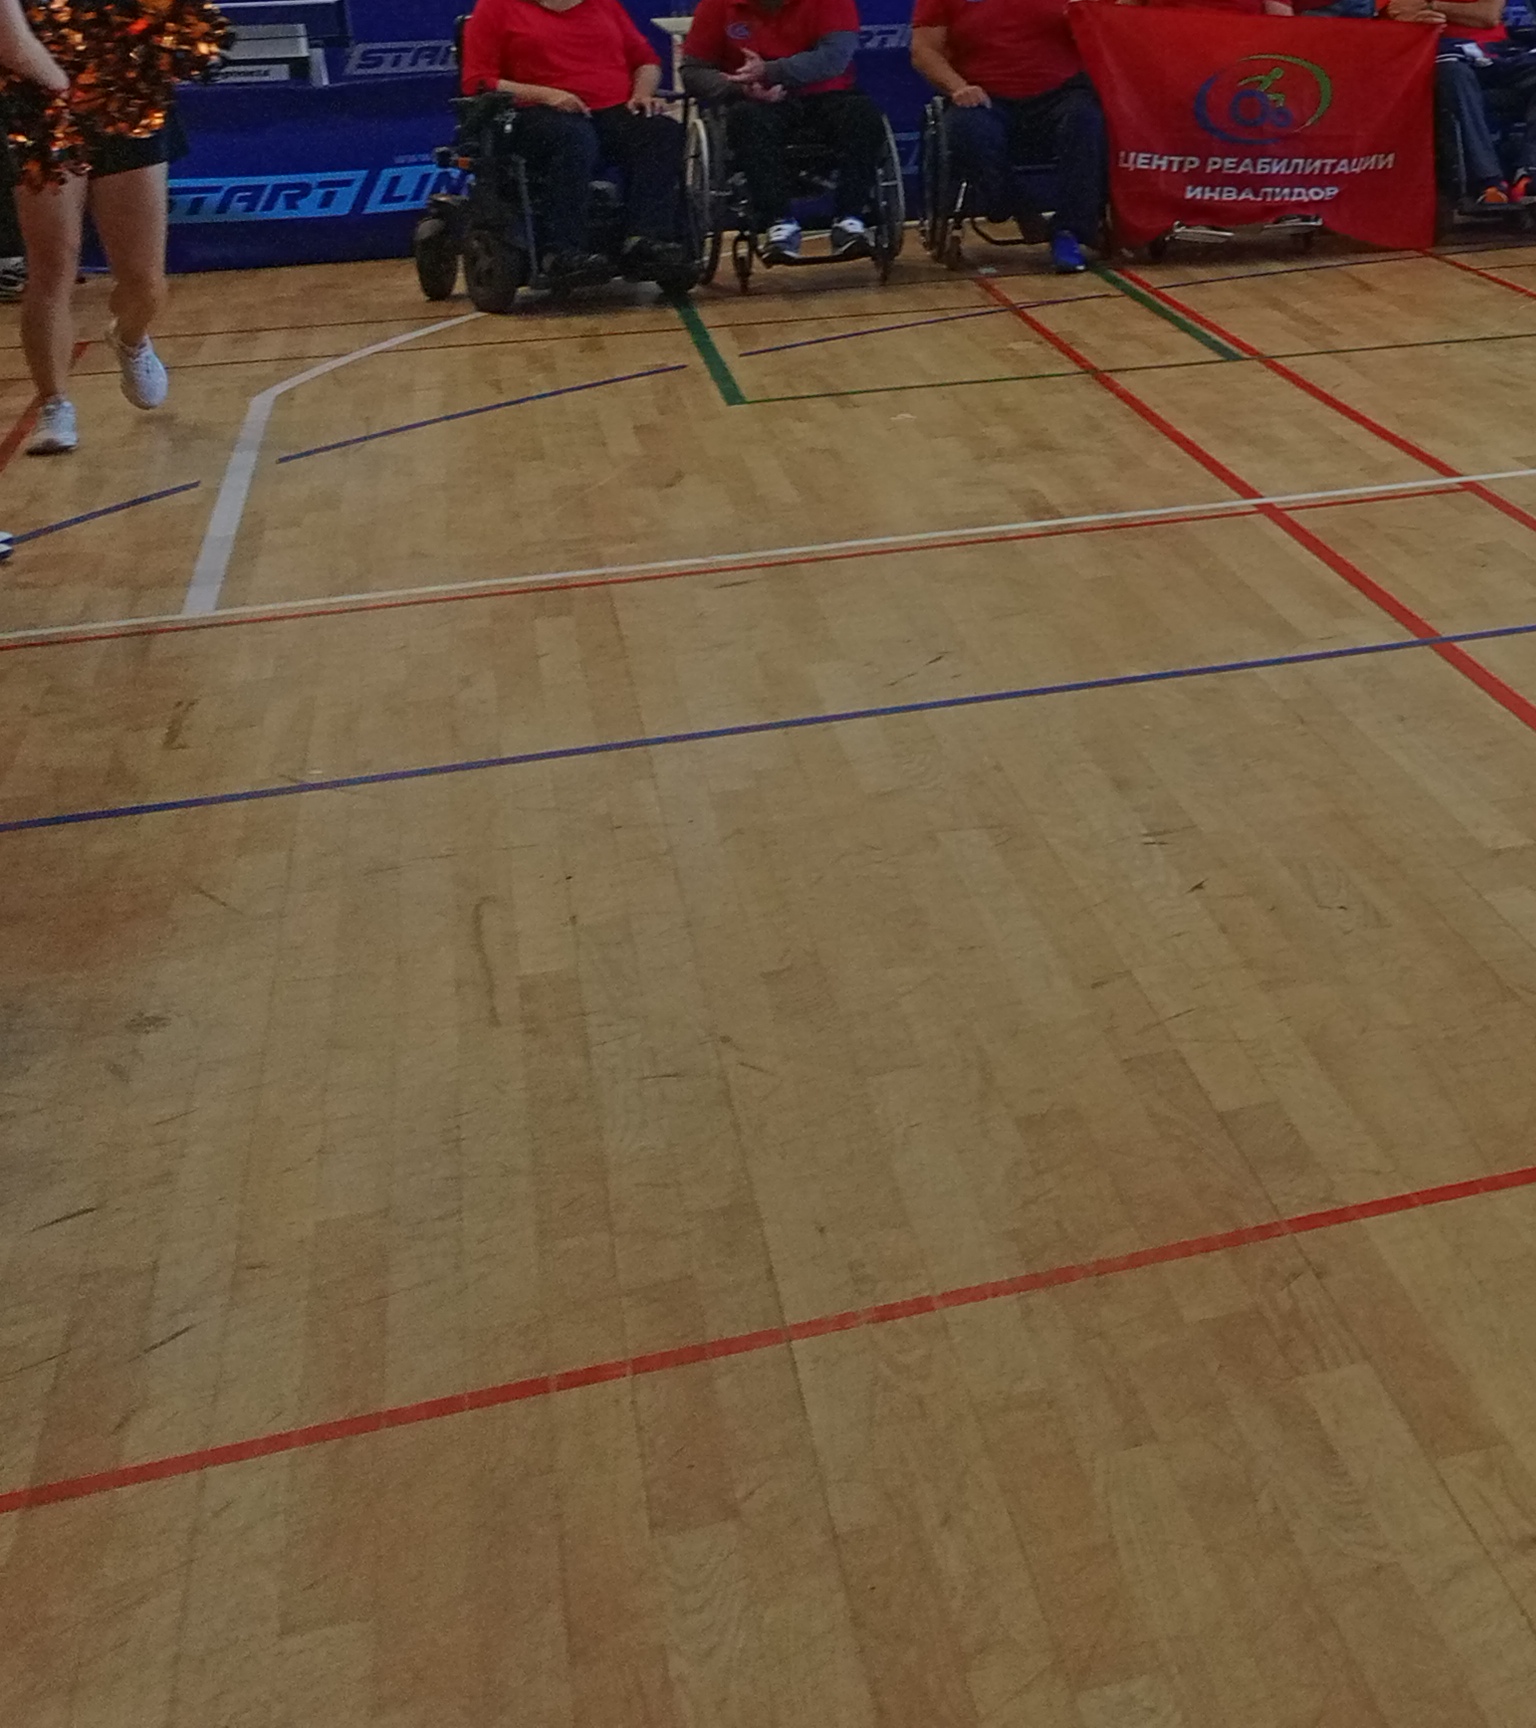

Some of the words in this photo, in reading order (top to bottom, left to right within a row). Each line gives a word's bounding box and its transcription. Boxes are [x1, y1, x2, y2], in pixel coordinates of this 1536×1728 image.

[1118, 151, 1200, 172] ЦЕНТР
[1205, 152, 1396, 175] РЕАБИЛИТАЦИИ
[1184, 184, 1340, 203] ИНВАЛИДОВ
